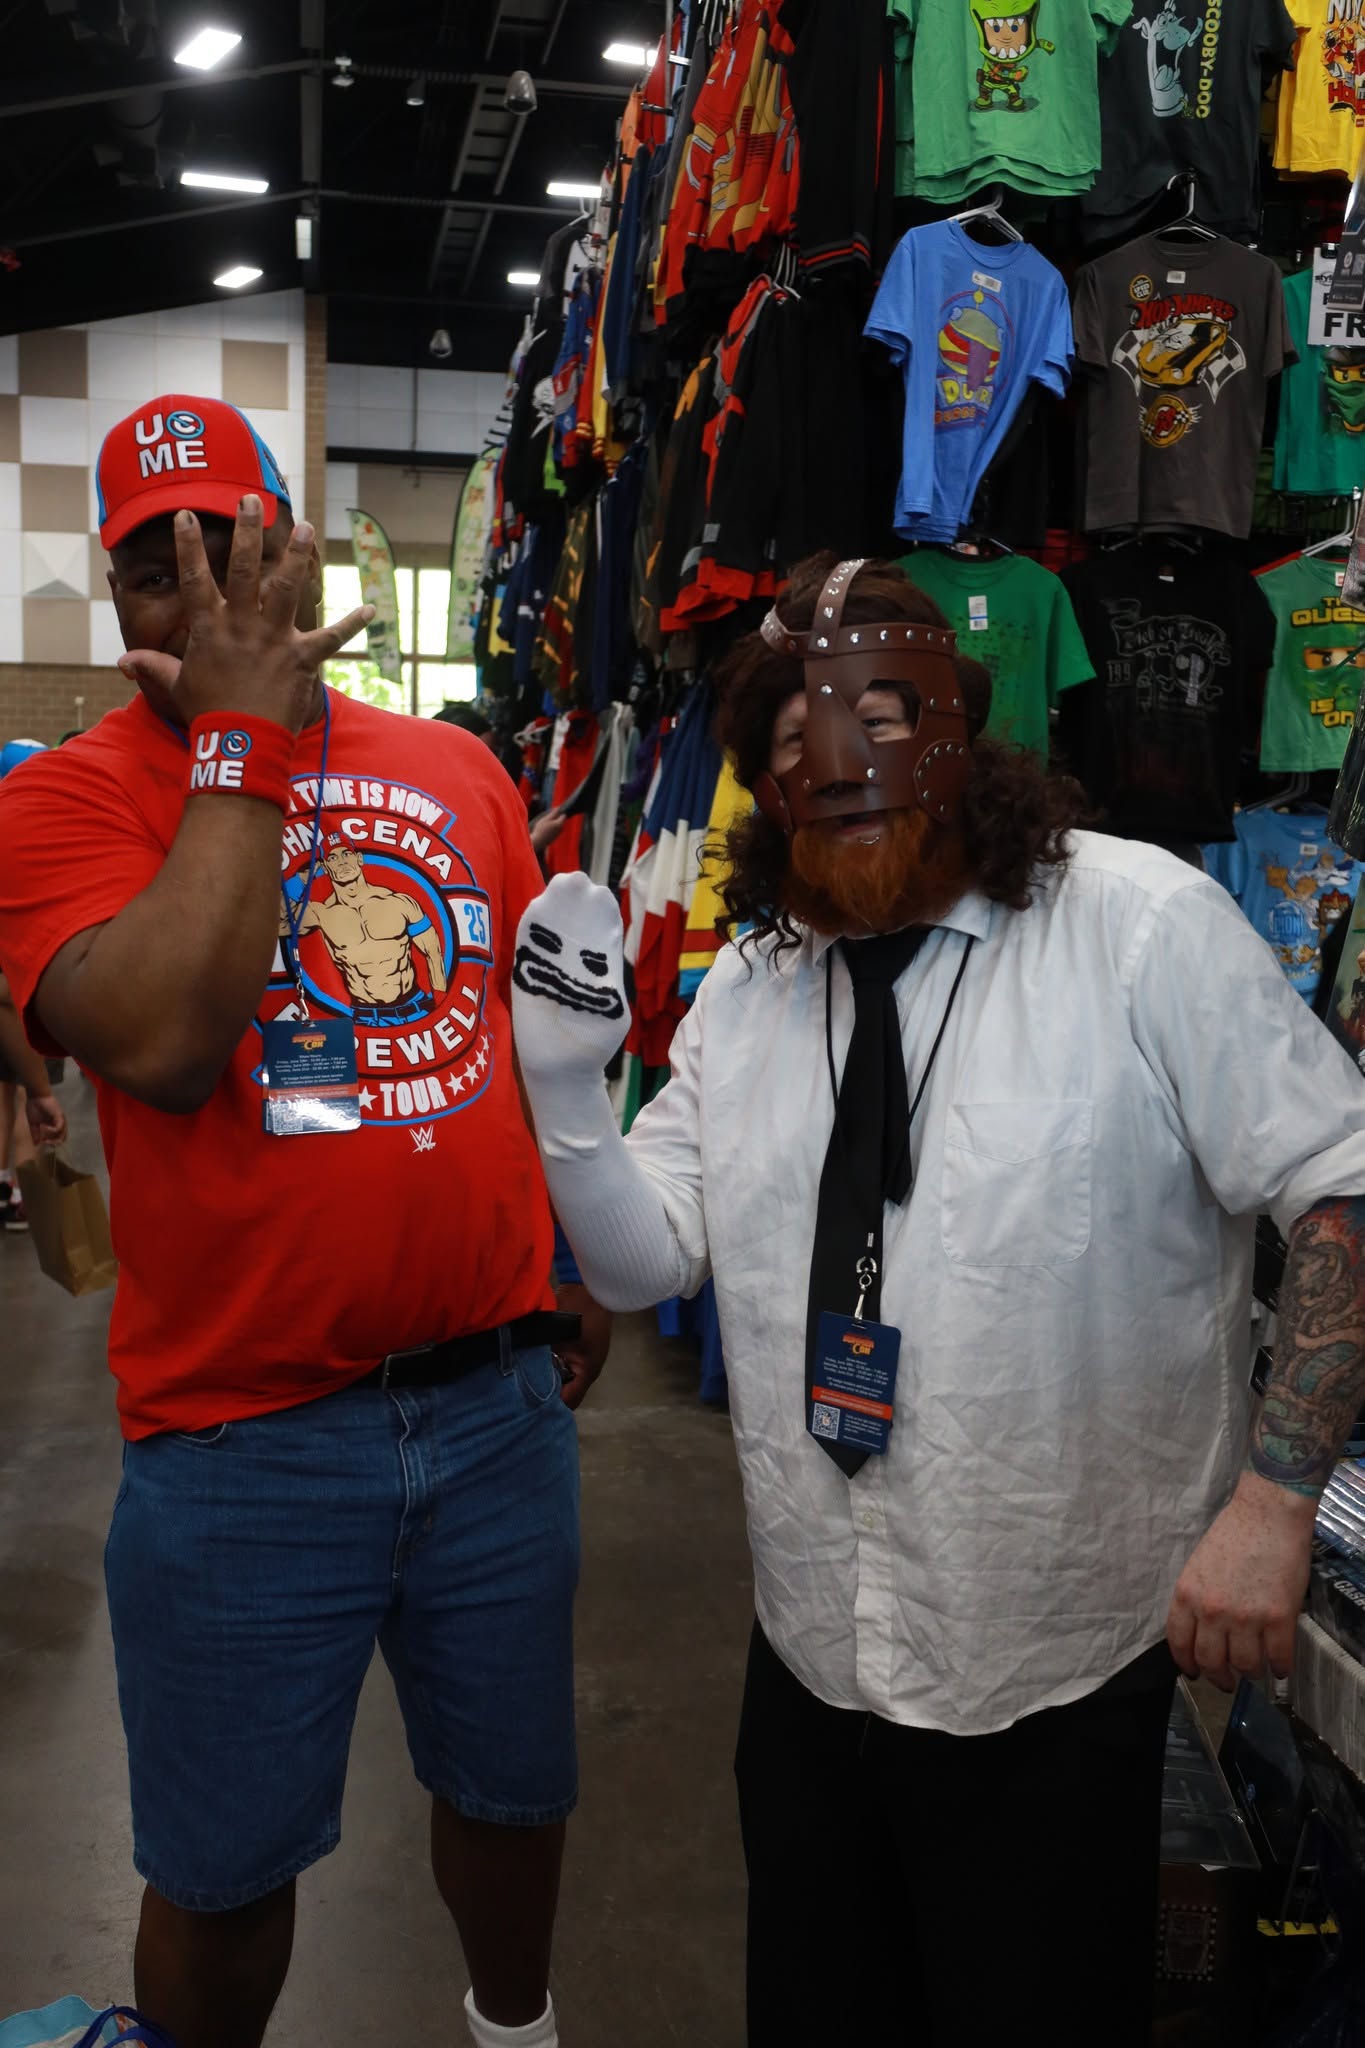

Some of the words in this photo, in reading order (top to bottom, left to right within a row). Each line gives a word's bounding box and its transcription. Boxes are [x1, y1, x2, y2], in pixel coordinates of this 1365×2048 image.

[139, 440, 208, 478] ME
[1310, 698, 1334, 714] IS
[190, 759, 245, 790] ME
[293, 778, 357, 808] TIME
[360, 780, 385, 807] IS
[388, 786, 444, 827] NOW
[340, 817, 453, 882] CENA
[463, 903, 487, 945] 25
[380, 1076, 448, 1117] TOUR
